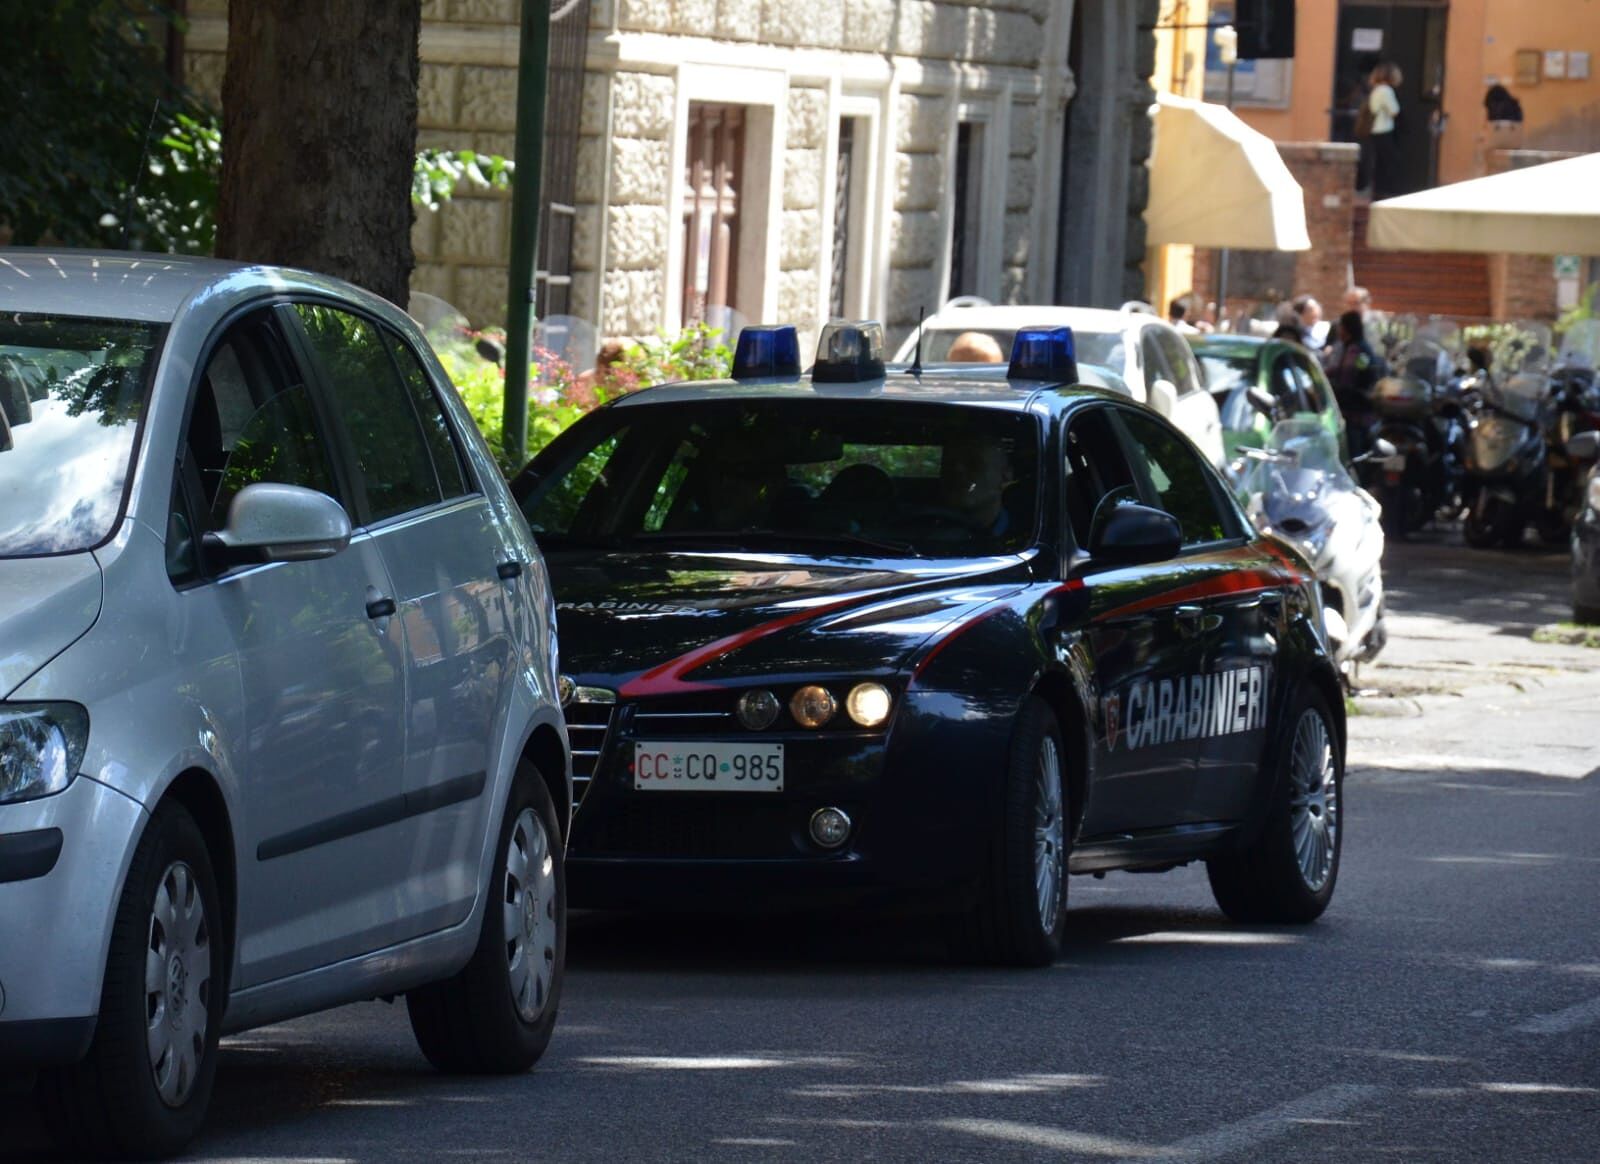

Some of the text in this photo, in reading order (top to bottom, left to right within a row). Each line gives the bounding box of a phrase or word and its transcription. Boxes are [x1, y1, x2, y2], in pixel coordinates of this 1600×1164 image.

[556, 602, 706, 617] RABINIER
[1126, 666, 1269, 750] CARABINIERI
[639, 753, 669, 780] CC
[732, 754, 781, 781] 985
